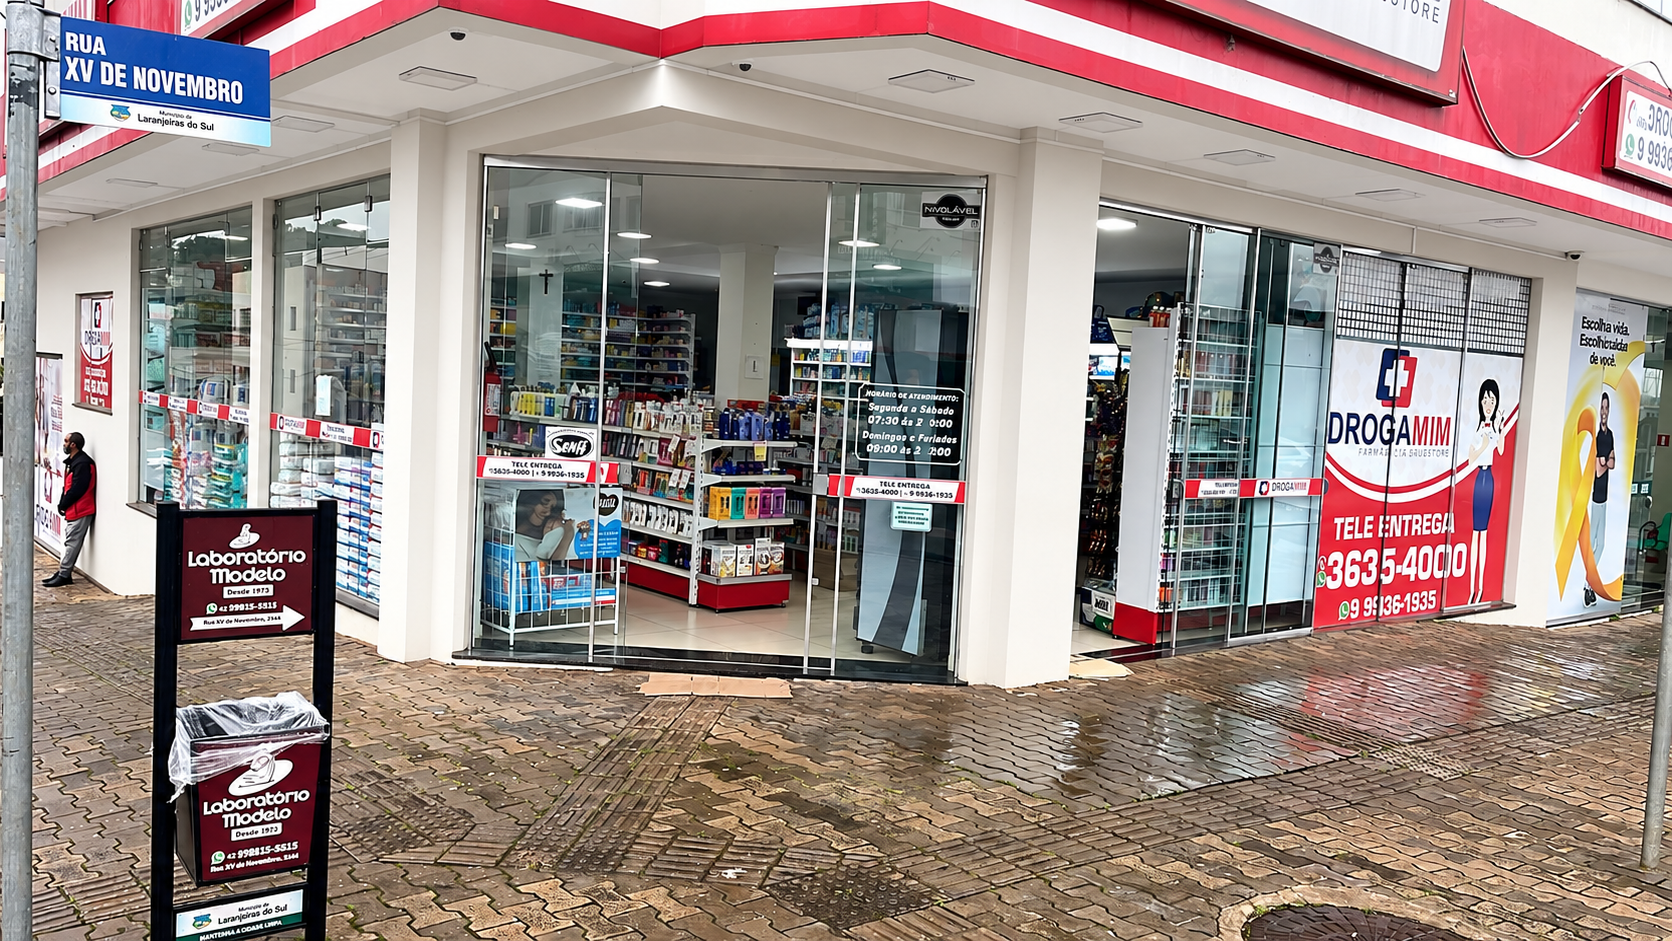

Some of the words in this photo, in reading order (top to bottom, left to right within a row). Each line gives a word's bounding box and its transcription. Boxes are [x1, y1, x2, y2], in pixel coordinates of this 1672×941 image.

[65, 32, 107, 56] RUA
[64, 56, 94, 83] XV
[100, 62, 128, 88] DE
[133, 67, 243, 104] NOVEMBRO
[137, 113, 185, 128] Laranjeiras
[187, 121, 198, 129] do
[200, 122, 215, 131] Sul
[1637, 136, 1645, 161] 9
[1581, 316, 1612, 333] Escolha
[1612, 321, 1630, 336] vida.
[865, 389, 897, 399] HORÁRIO
[867, 415, 900, 426] 07:30
[1327, 411, 1452, 446] DROGAMIM
[866, 443, 898, 454] 09:00
[879, 480, 896, 488] TELE
[897, 482, 931, 490] ENTREGA
[1334, 515, 1374, 541] TELE
[1378, 512, 1455, 538] ENTREGA
[188, 549, 306, 567] Laboratório
[1326, 543, 1468, 590] 3635-4000
[209, 567, 286, 584] Modelo
[227, 588, 250, 596] Desde
[252, 587, 270, 595] 1973
[1350, 598, 1360, 619] 9
[203, 790, 310, 815] Laboratório
[222, 807, 292, 828] Modelo
[235, 829, 259, 838] Desde
[225, 862, 236, 871] XV
[218, 911, 261, 925] Laranjeiras
[262, 907, 273, 916] do
[274, 904, 288, 913] Sul
[199, 929, 235, 941] MANTENHA
